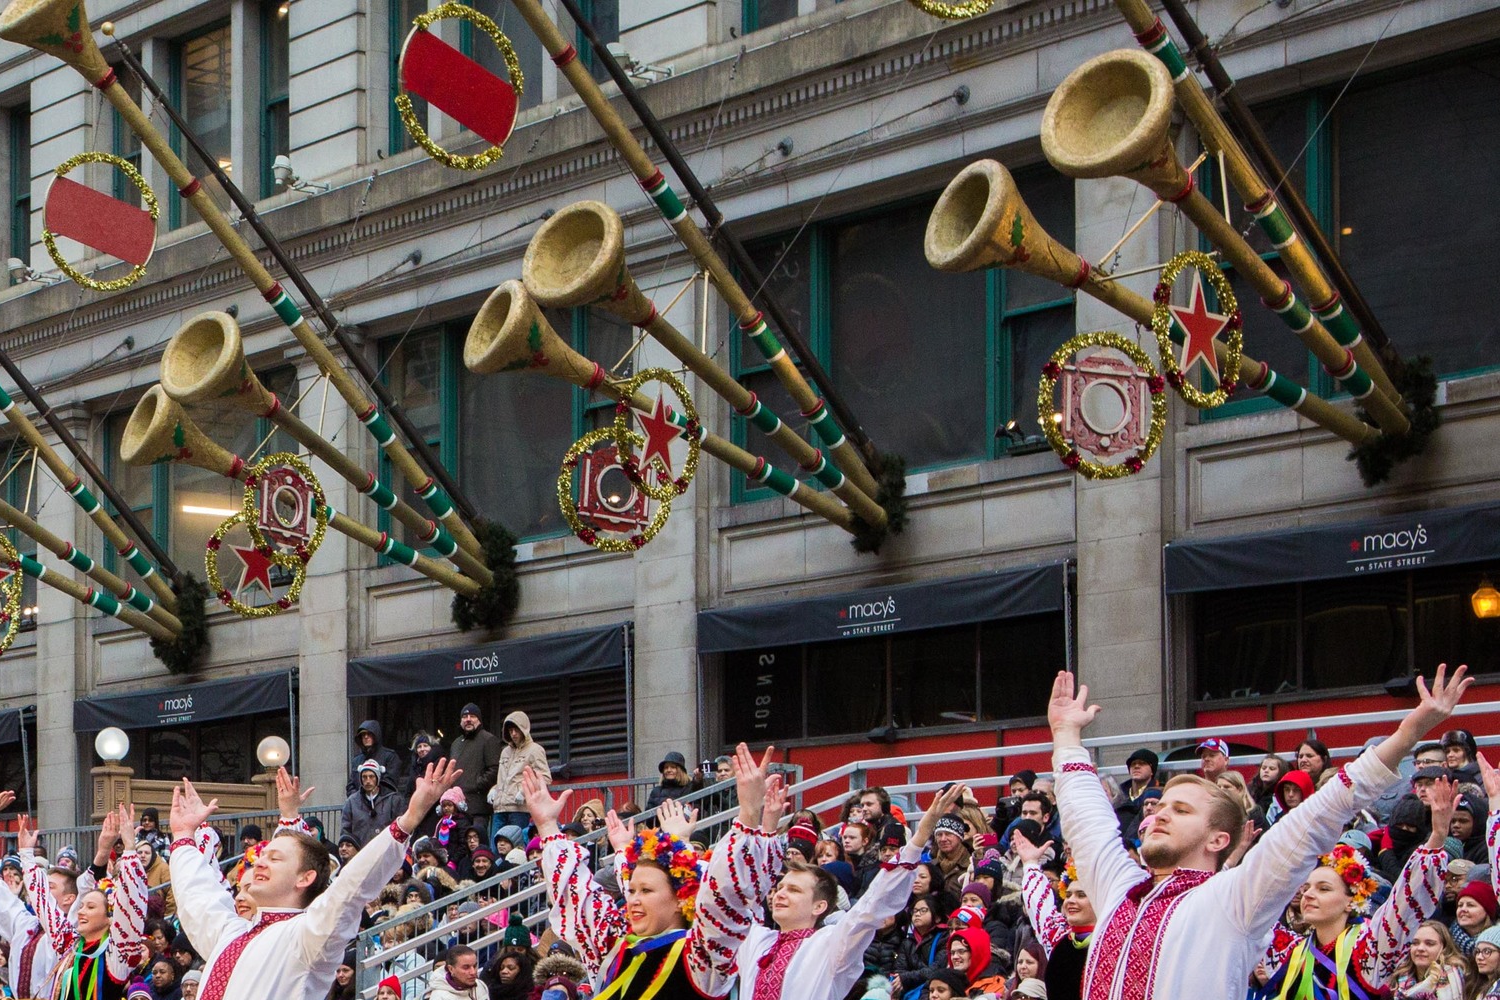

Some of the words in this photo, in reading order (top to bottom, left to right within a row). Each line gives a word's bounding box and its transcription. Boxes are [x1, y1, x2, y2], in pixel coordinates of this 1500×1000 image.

[1363, 524, 1428, 552] macy's
[1368, 561, 1393, 570] STATE
[1396, 556, 1426, 567] STREET
[849, 596, 896, 619] macy's
[852, 626, 870, 635] STATE
[873, 623, 895, 632] STREET
[463, 652, 499, 671] macy's
[164, 694, 193, 711] macy's
